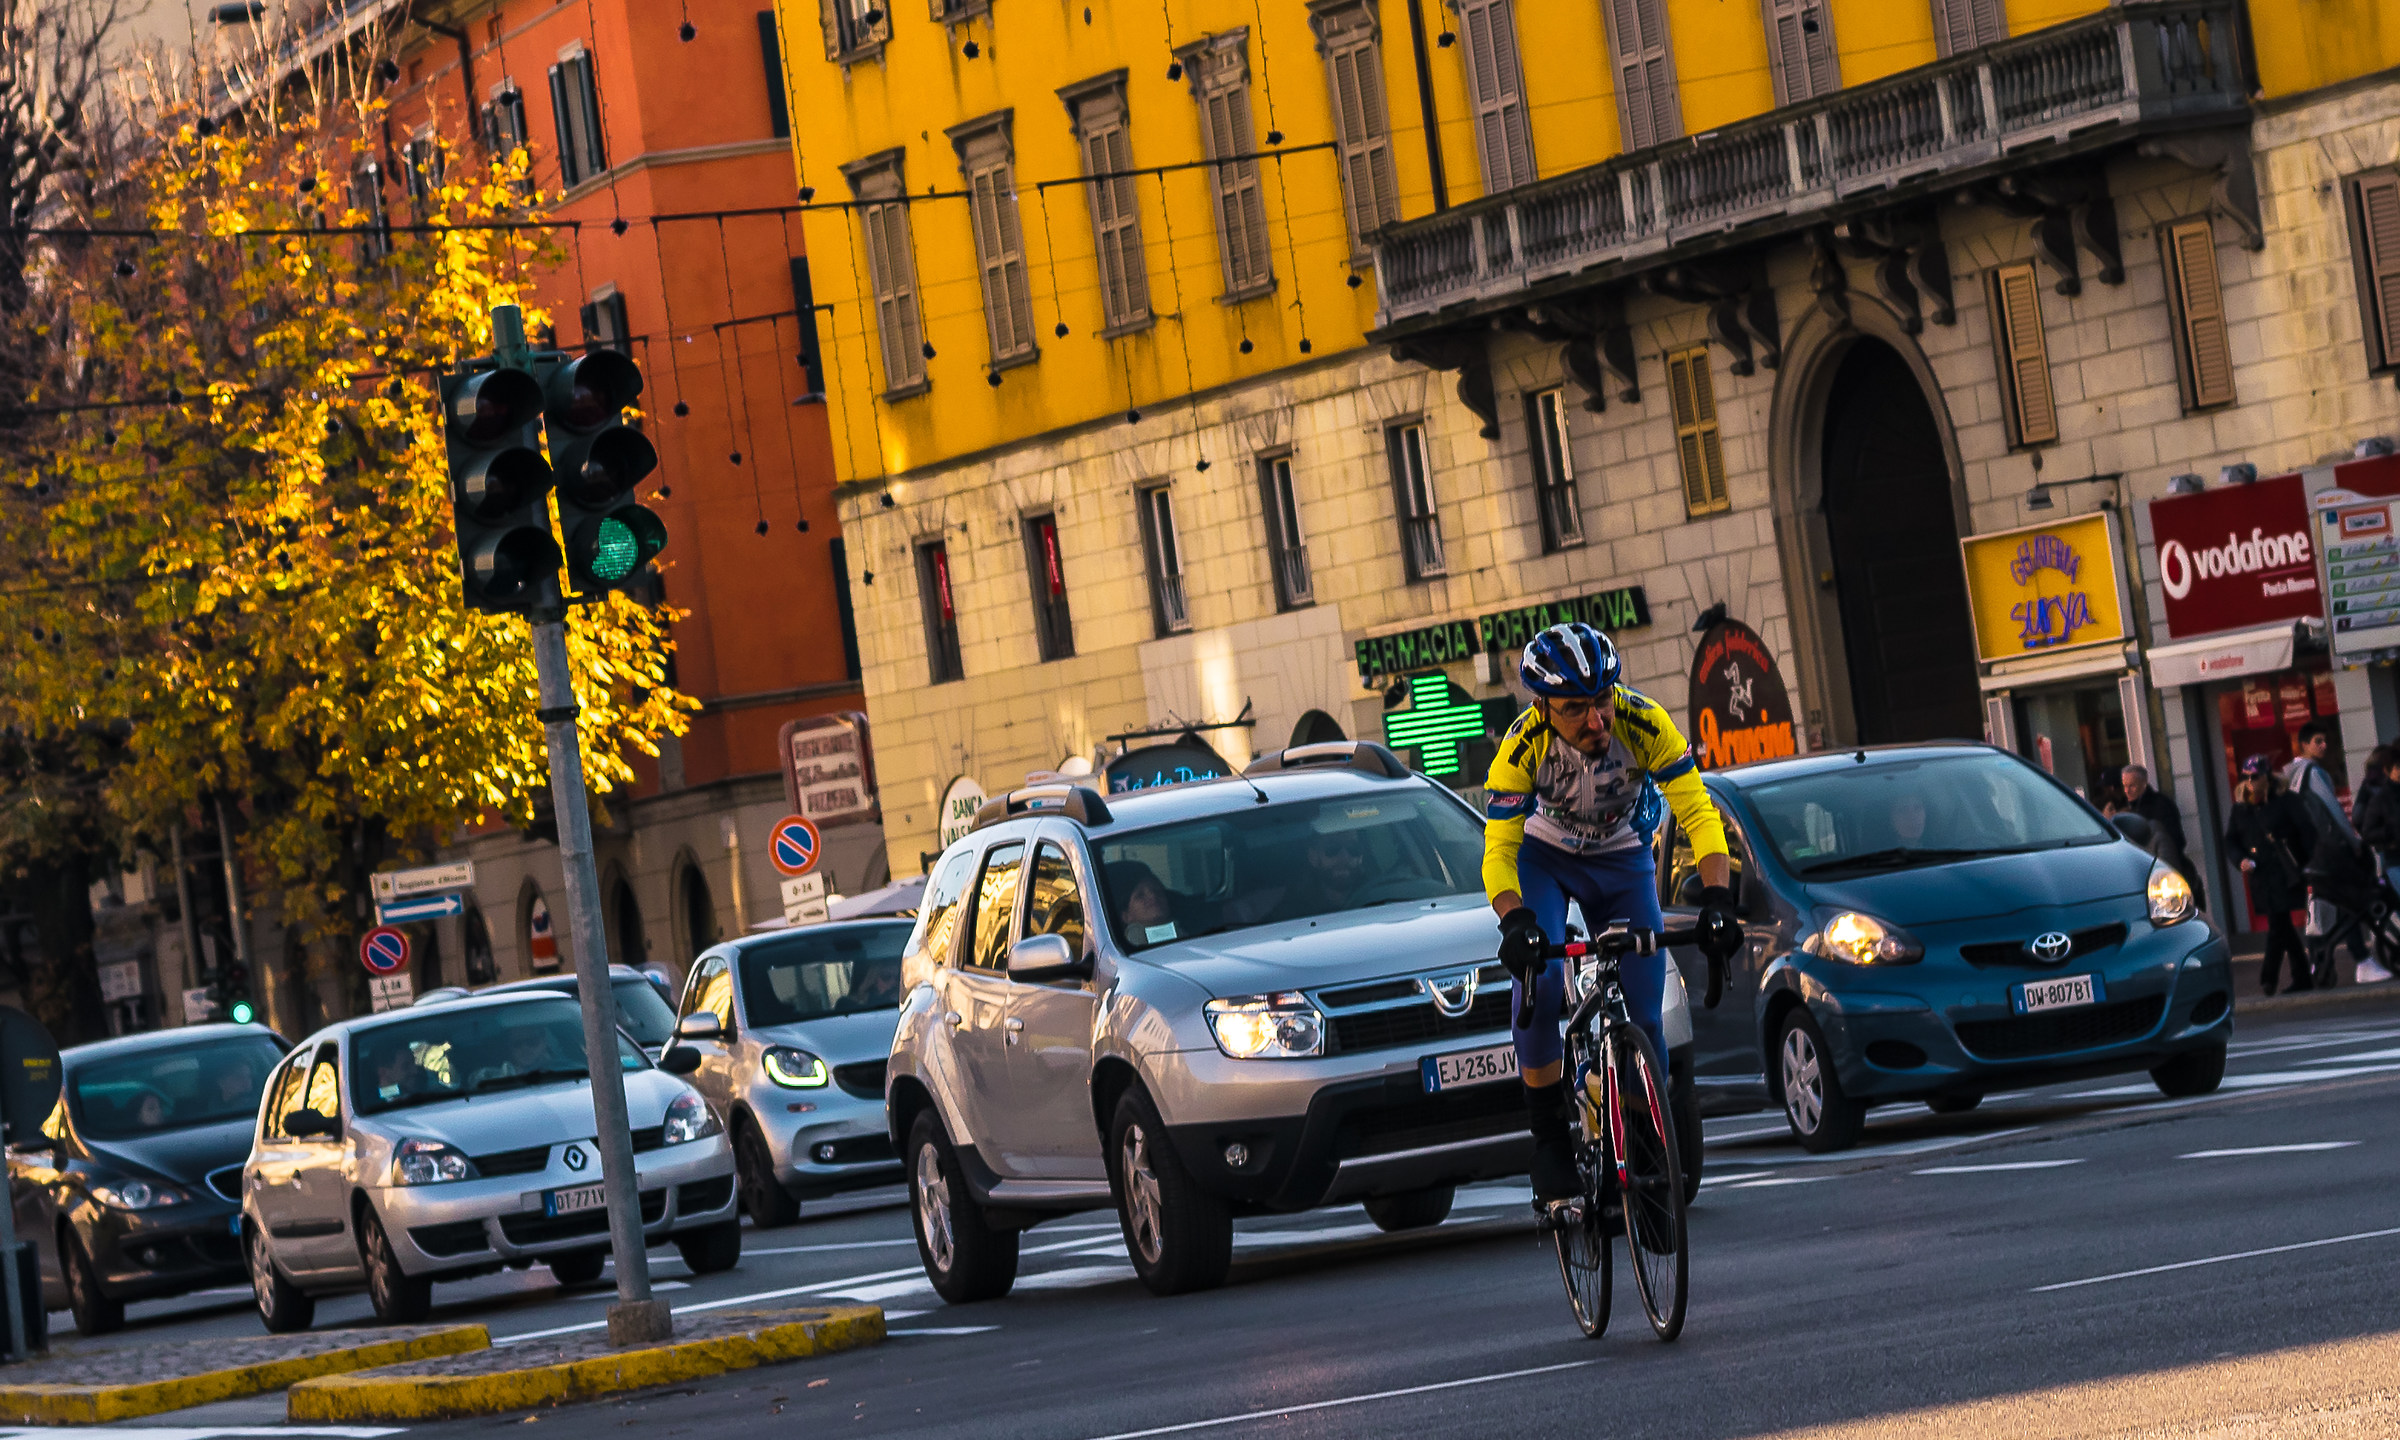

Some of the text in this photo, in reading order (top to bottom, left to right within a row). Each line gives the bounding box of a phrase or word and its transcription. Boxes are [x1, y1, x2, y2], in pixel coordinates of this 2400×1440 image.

[2192, 527, 2311, 580] vodafone
[1356, 621, 1470, 675] FARMACIA
[1481, 604, 1551, 653] PORTA
